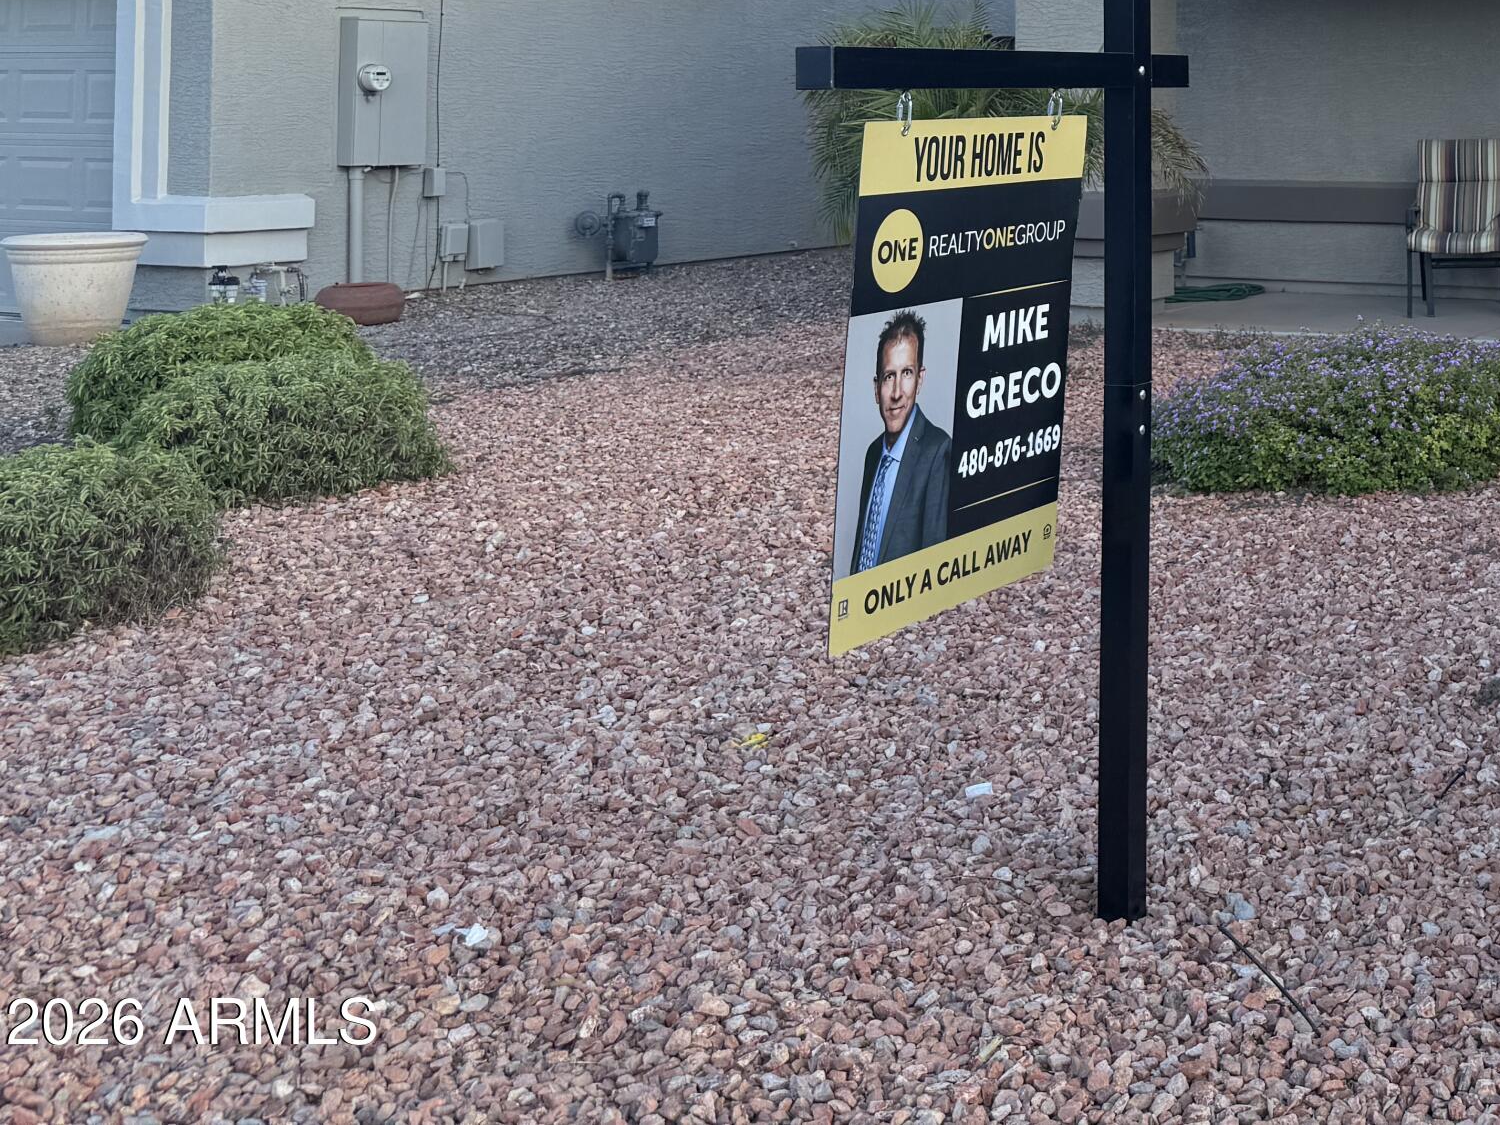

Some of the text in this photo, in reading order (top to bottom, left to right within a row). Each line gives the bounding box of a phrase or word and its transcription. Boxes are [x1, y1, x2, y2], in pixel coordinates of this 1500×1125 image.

[914, 131, 1046, 183] YOUR HOME IS
[877, 237, 919, 264] ONE
[982, 303, 1050, 352] MIKE
[966, 362, 1062, 419] GRECO
[957, 424, 1061, 478] 480-876-1669
[864, 529, 1032, 614] ONLY A CALL AWAY
